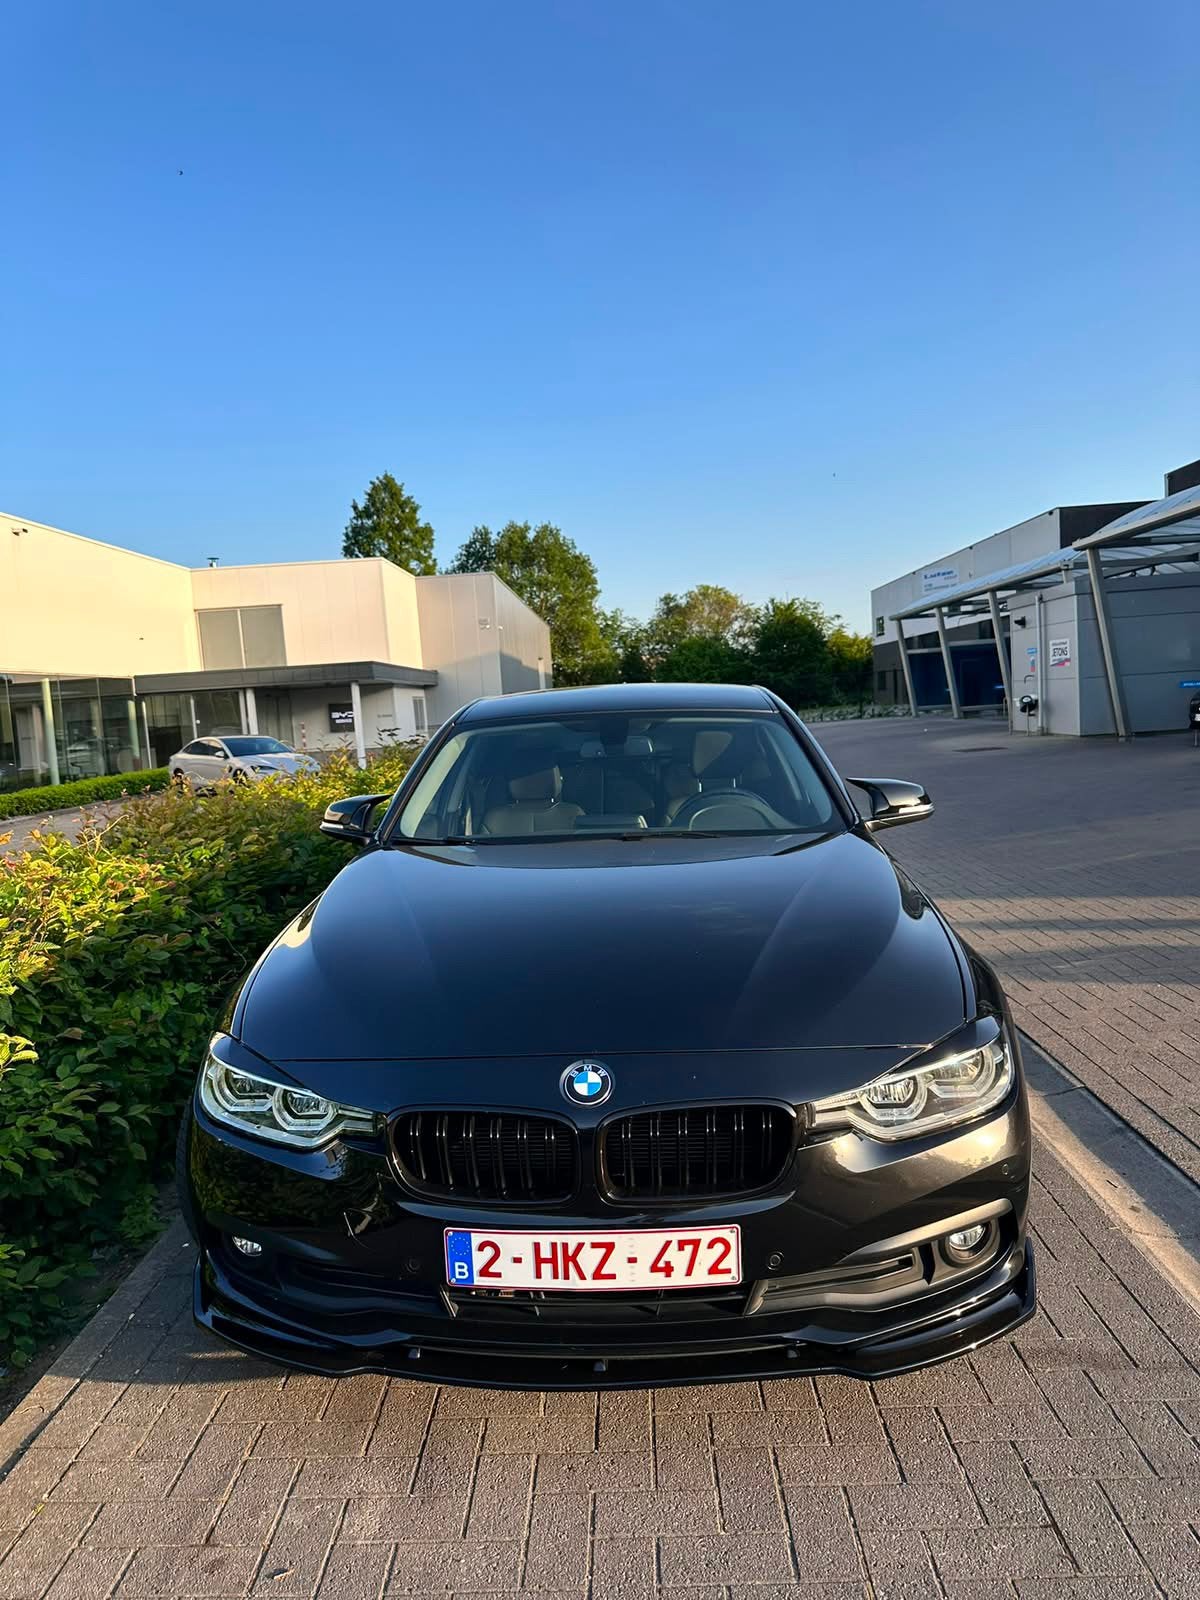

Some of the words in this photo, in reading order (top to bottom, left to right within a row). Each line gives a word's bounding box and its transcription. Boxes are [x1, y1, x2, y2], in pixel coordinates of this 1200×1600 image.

[570, 1064, 607, 1077] BMW
[476, 1236, 732, 1281] 2-HKZ-472
[455, 1262, 469, 1280] B
